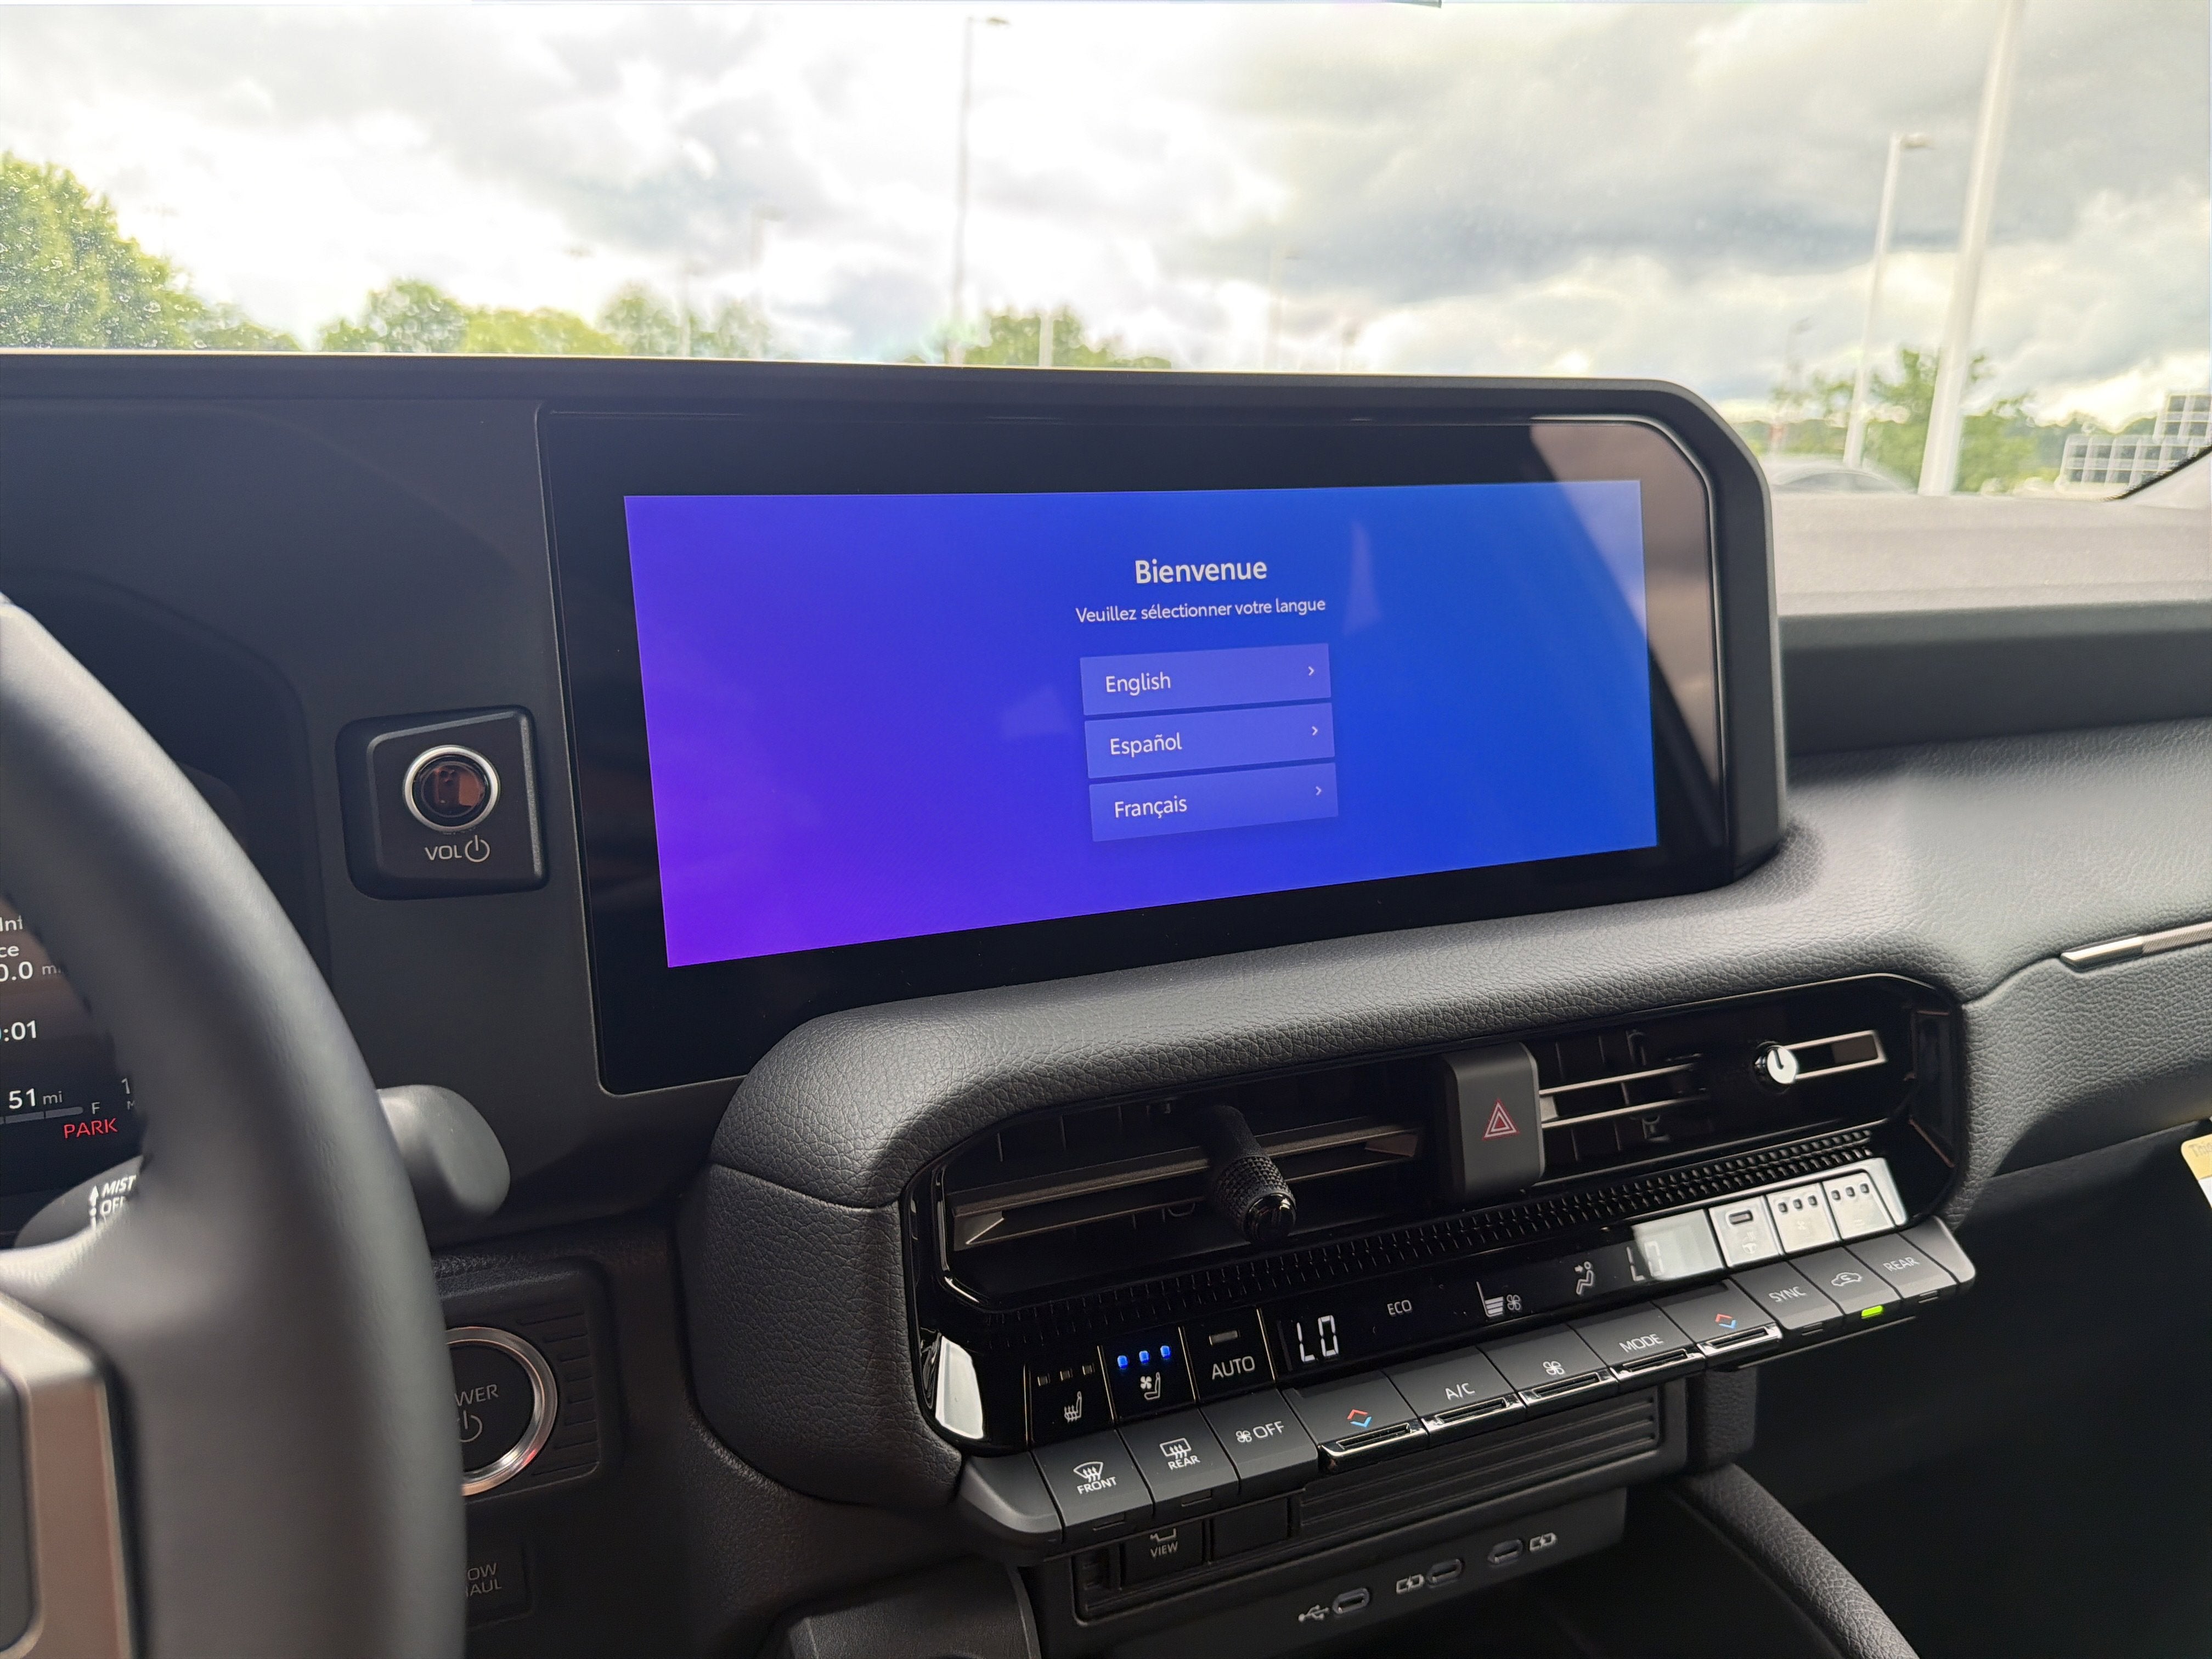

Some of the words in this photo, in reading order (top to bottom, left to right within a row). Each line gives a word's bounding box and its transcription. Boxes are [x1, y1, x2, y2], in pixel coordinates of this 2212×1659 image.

[1135, 558, 1267, 584] Bienvenue
[1075, 605, 1137, 623] Veuillez
[1141, 603, 1232, 619] sélectionner
[1234, 601, 1272, 615] votre
[1276, 598, 1325, 616] langue
[1105, 672, 1171, 696] English
[1110, 732, 1182, 758] Español
[1115, 795, 1187, 819] Français
[425, 845, 462, 861] VOL
[0, 945, 20, 958] ce
[0, 1020, 37, 1042] :01
[9, 1088, 36, 1109] 51
[43, 1091, 63, 1105] mi
[92, 1102, 100, 1114] F
[64, 1118, 118, 1139] PARK
[101, 1175, 137, 1198] MIST
[1882, 1256, 1918, 1272] REAR
[1768, 1286, 1807, 1303] SYNC
[1387, 1300, 1412, 1316] ECO
[1618, 1333, 1664, 1353] MODE
[1212, 1356, 1255, 1380] AUTO
[454, 1384, 499, 1406] WER
[1445, 1383, 1475, 1401] A/C
[1252, 1420, 1284, 1438] OFF
[1167, 1455, 1201, 1470] REAR
[1077, 1476, 1117, 1494] FRONT
[1150, 1541, 1178, 1558] VIEW
[467, 1563, 497, 1581] OW
